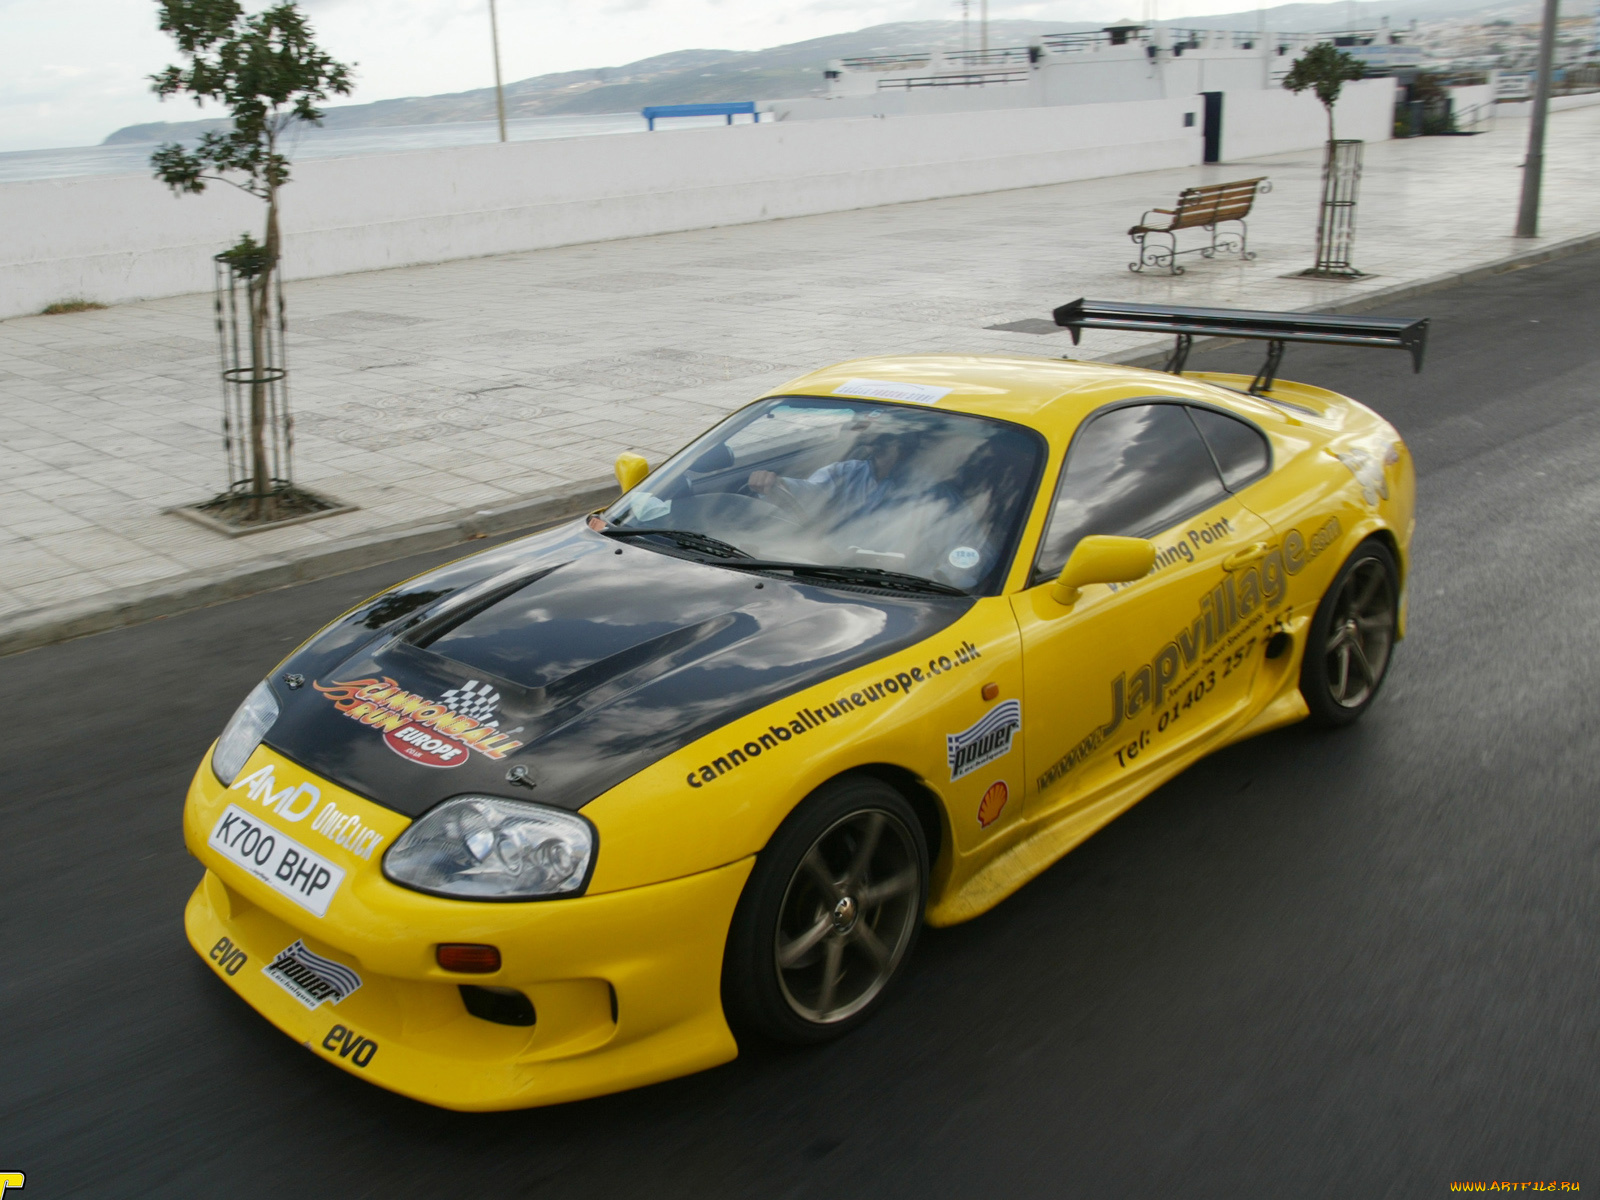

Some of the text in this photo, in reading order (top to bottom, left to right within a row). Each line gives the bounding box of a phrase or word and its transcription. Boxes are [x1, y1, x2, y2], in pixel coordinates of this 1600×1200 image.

[1187, 516, 1235, 550] Point
[344, 701, 413, 733] RUN
[355, 682, 524, 760] CANNONBALL
[686, 641, 982, 788] cannonballruneurope.co.uk
[1113, 728, 1151, 768] Tel:
[1157, 671, 1216, 732] 01403
[1222, 636, 1257, 679] 257
[394, 727, 463, 761] EUROPE
[953, 722, 1019, 777] power
[216, 812, 331, 896] K700 BHP
[209, 936, 248, 977] evo
[269, 952, 341, 1003] power
[322, 1023, 379, 1068] evo
